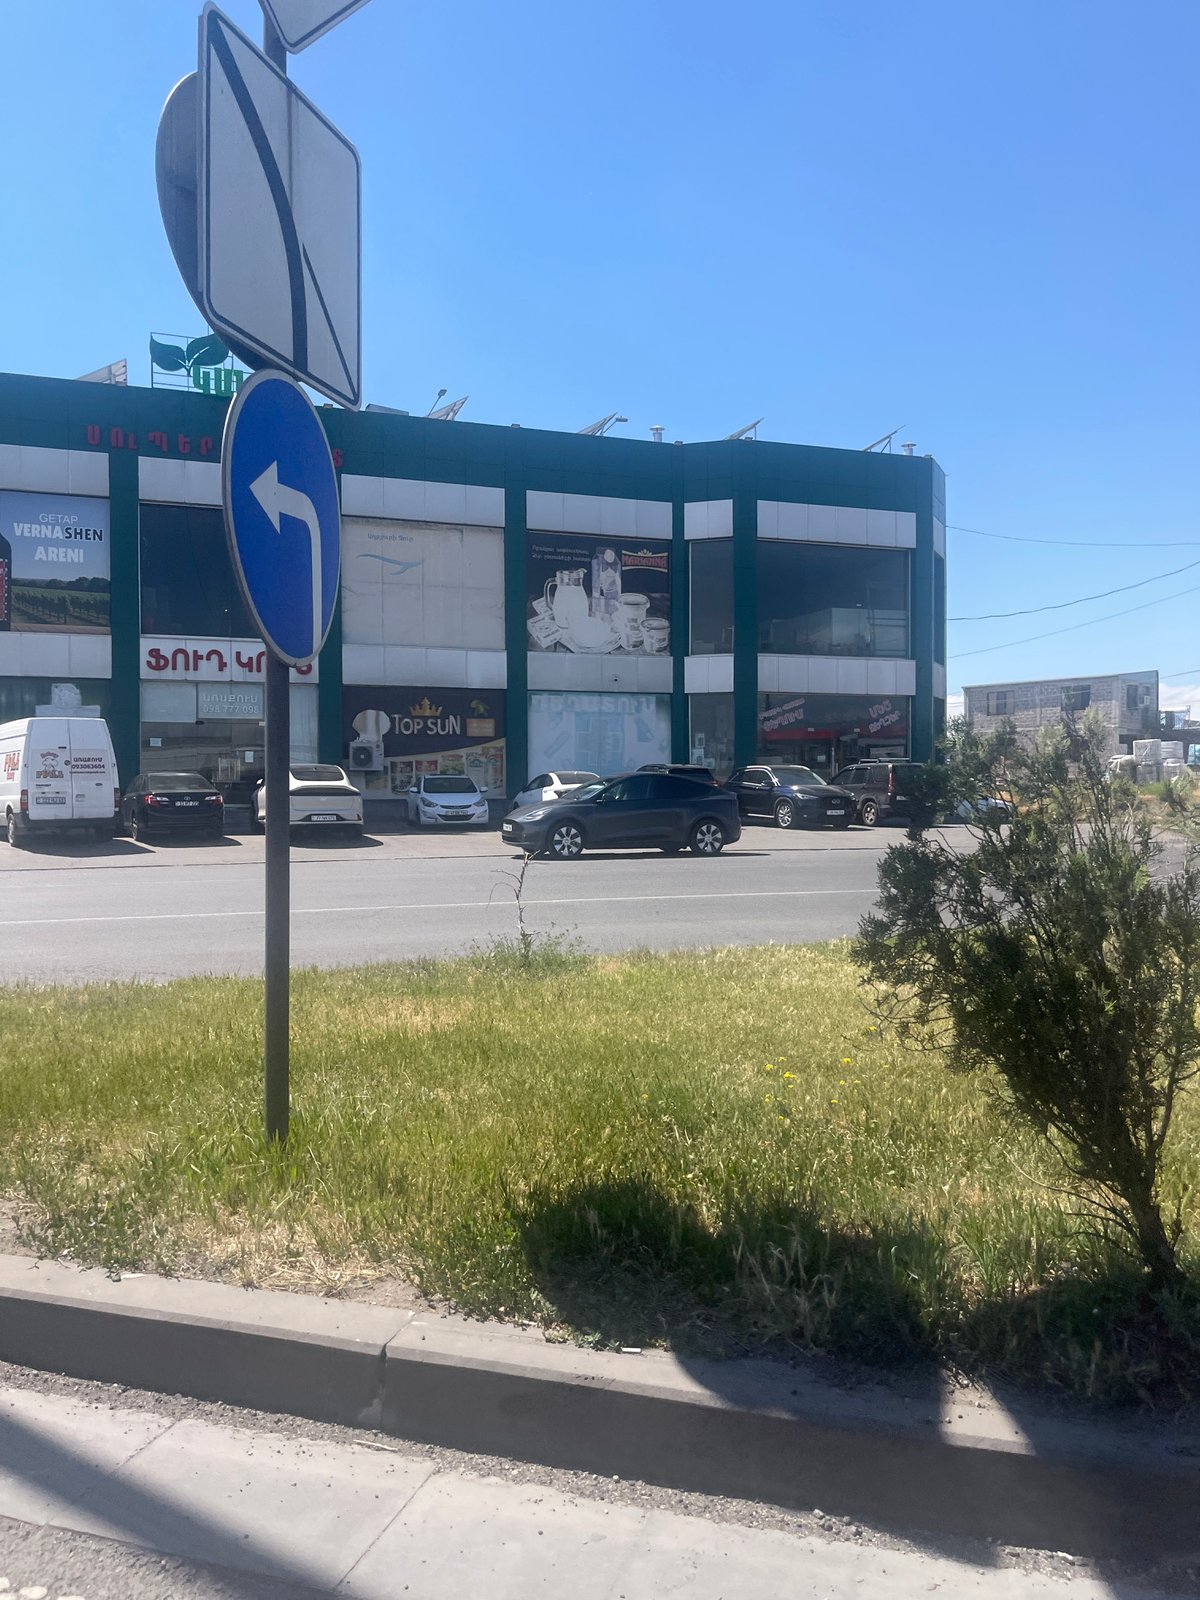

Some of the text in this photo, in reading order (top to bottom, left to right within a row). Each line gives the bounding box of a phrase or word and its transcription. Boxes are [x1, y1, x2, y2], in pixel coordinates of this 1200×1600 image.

[39, 513, 79, 524] GETAP
[13, 523, 104, 541] VERNASHEN
[34, 546, 84, 563] ARENI
[146, 648, 227, 672] ՖՈՒԴ
[391, 714, 424, 735] TOP
